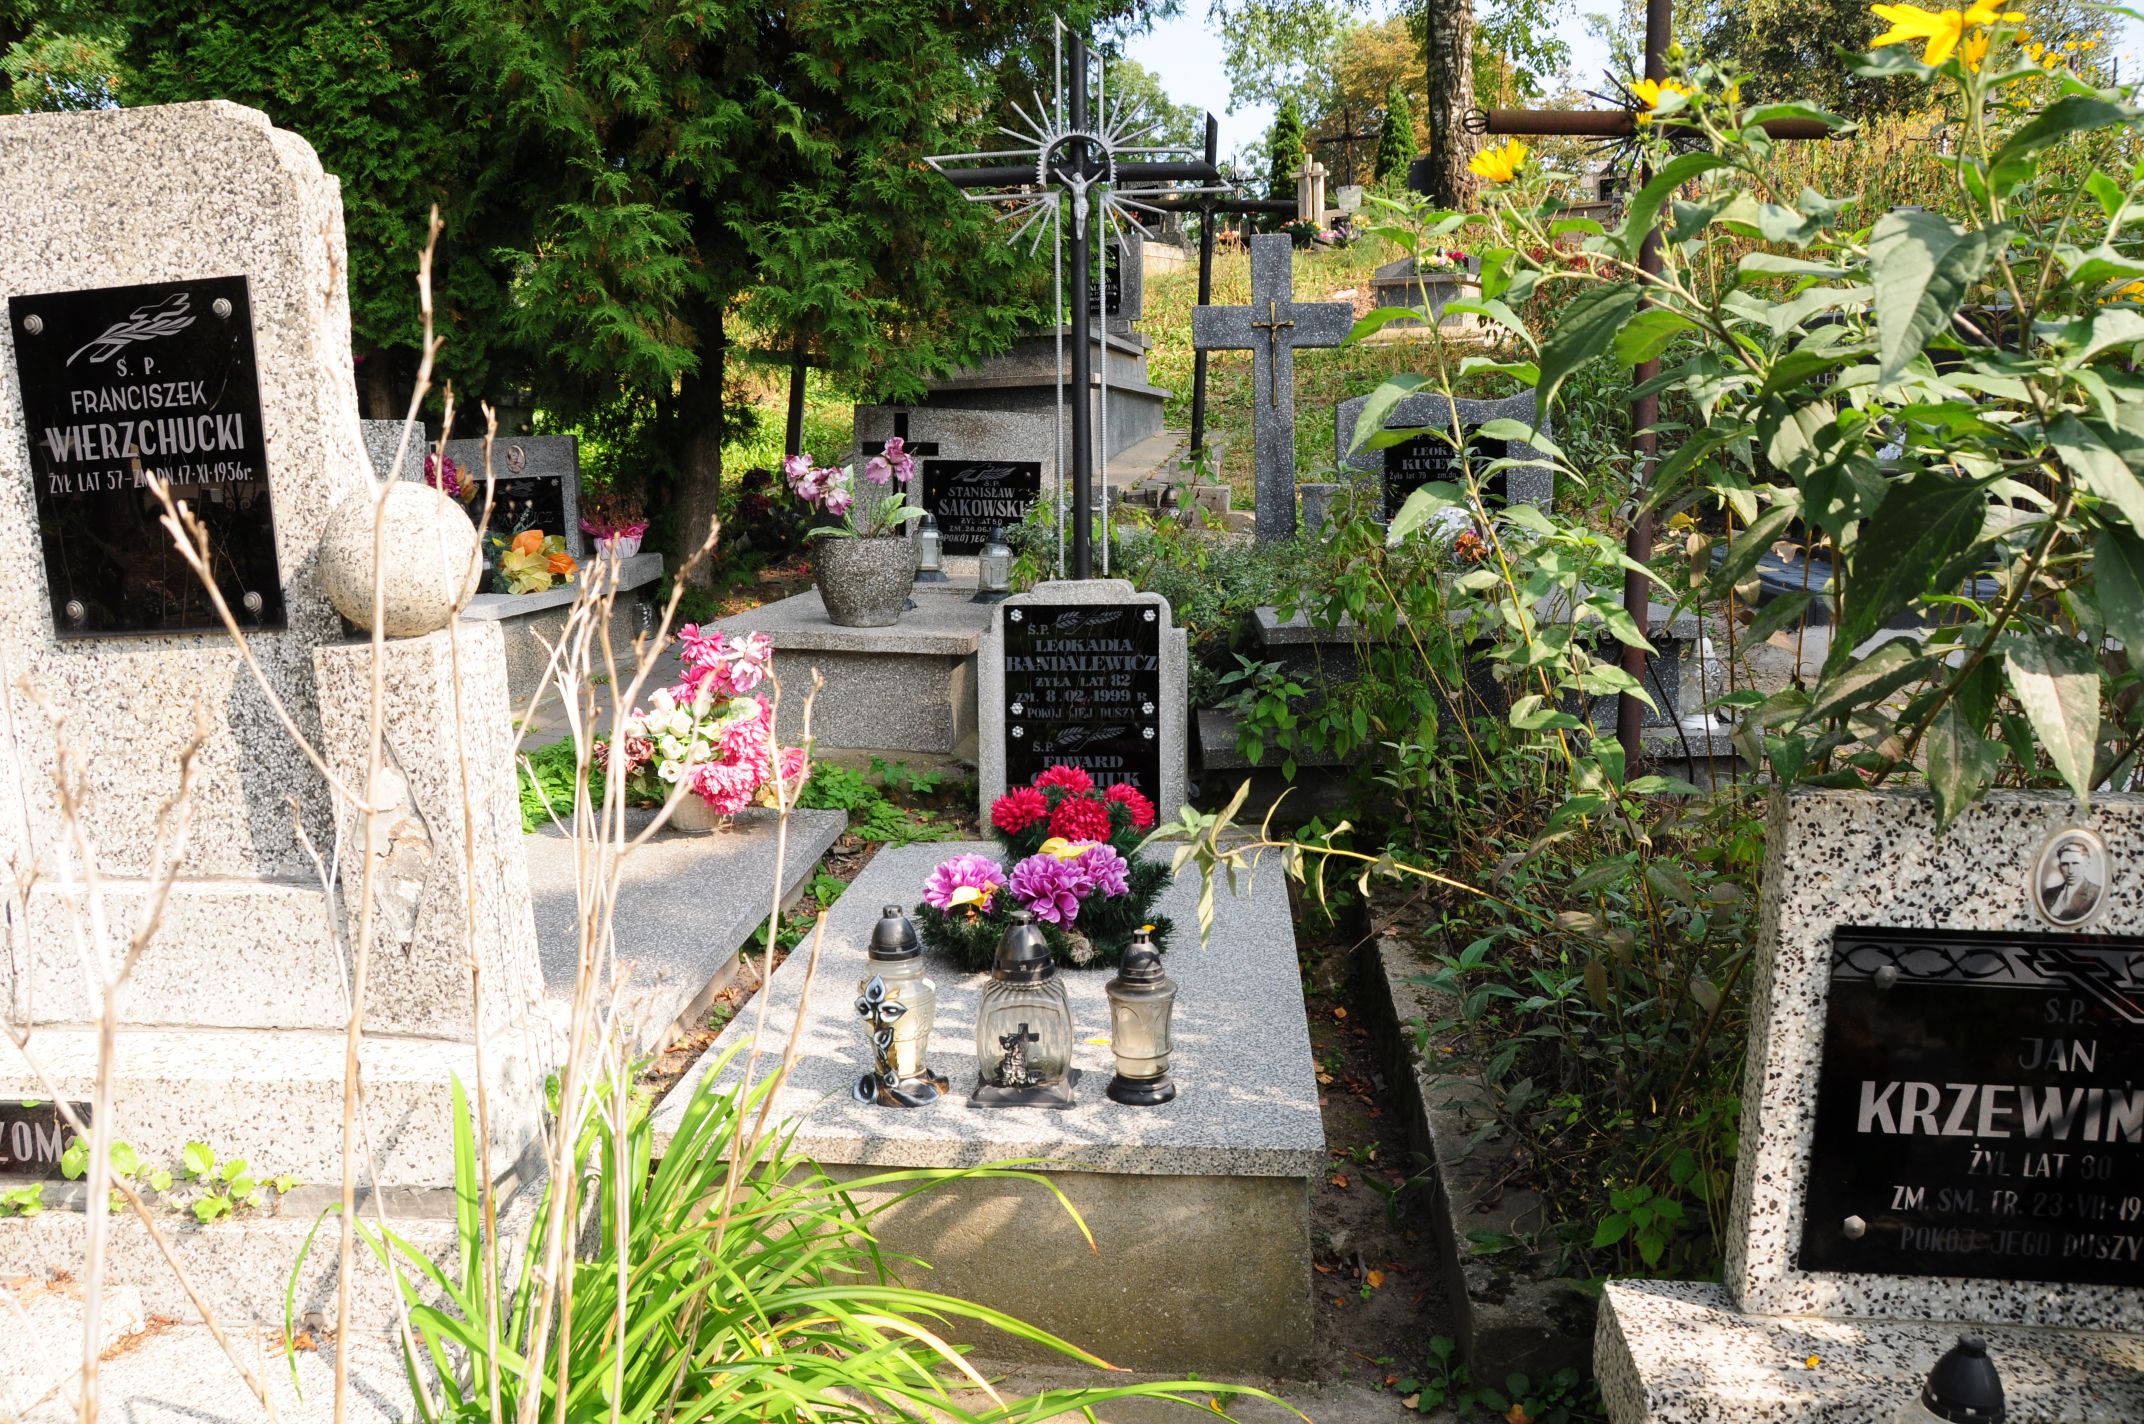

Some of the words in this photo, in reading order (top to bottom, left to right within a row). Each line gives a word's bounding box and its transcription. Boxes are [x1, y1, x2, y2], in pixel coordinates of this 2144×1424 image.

[70, 380, 207, 415] FRANCISZEK
[44, 413, 245, 463] WIERZCHUCKI
[77, 471, 100, 492] LAT
[947, 486, 1016, 499] STANISŁAW
[938, 498, 1025, 518] SAKOWSKI
[1035, 638, 1134, 652] LEOKADIA
[1006, 655, 1158, 672] BANDALEWICZ
[1080, 676, 1106, 687] LAT
[1110, 674, 1132, 687] 82
[1100, 706, 1138, 719] DUSZY
[1042, 755, 1125, 768] EDWARD
[2018, 1036, 2098, 1073] JAN
[2022, 1152, 2072, 1179] LAT
[2079, 1153, 2113, 1181] 30
[1890, 1184, 1930, 1211] ZM.
[1990, 1190, 2024, 1216] TR.
[1989, 1229, 2051, 1257] JEGO
[2062, 1231, 2144, 1263] DUSZY
